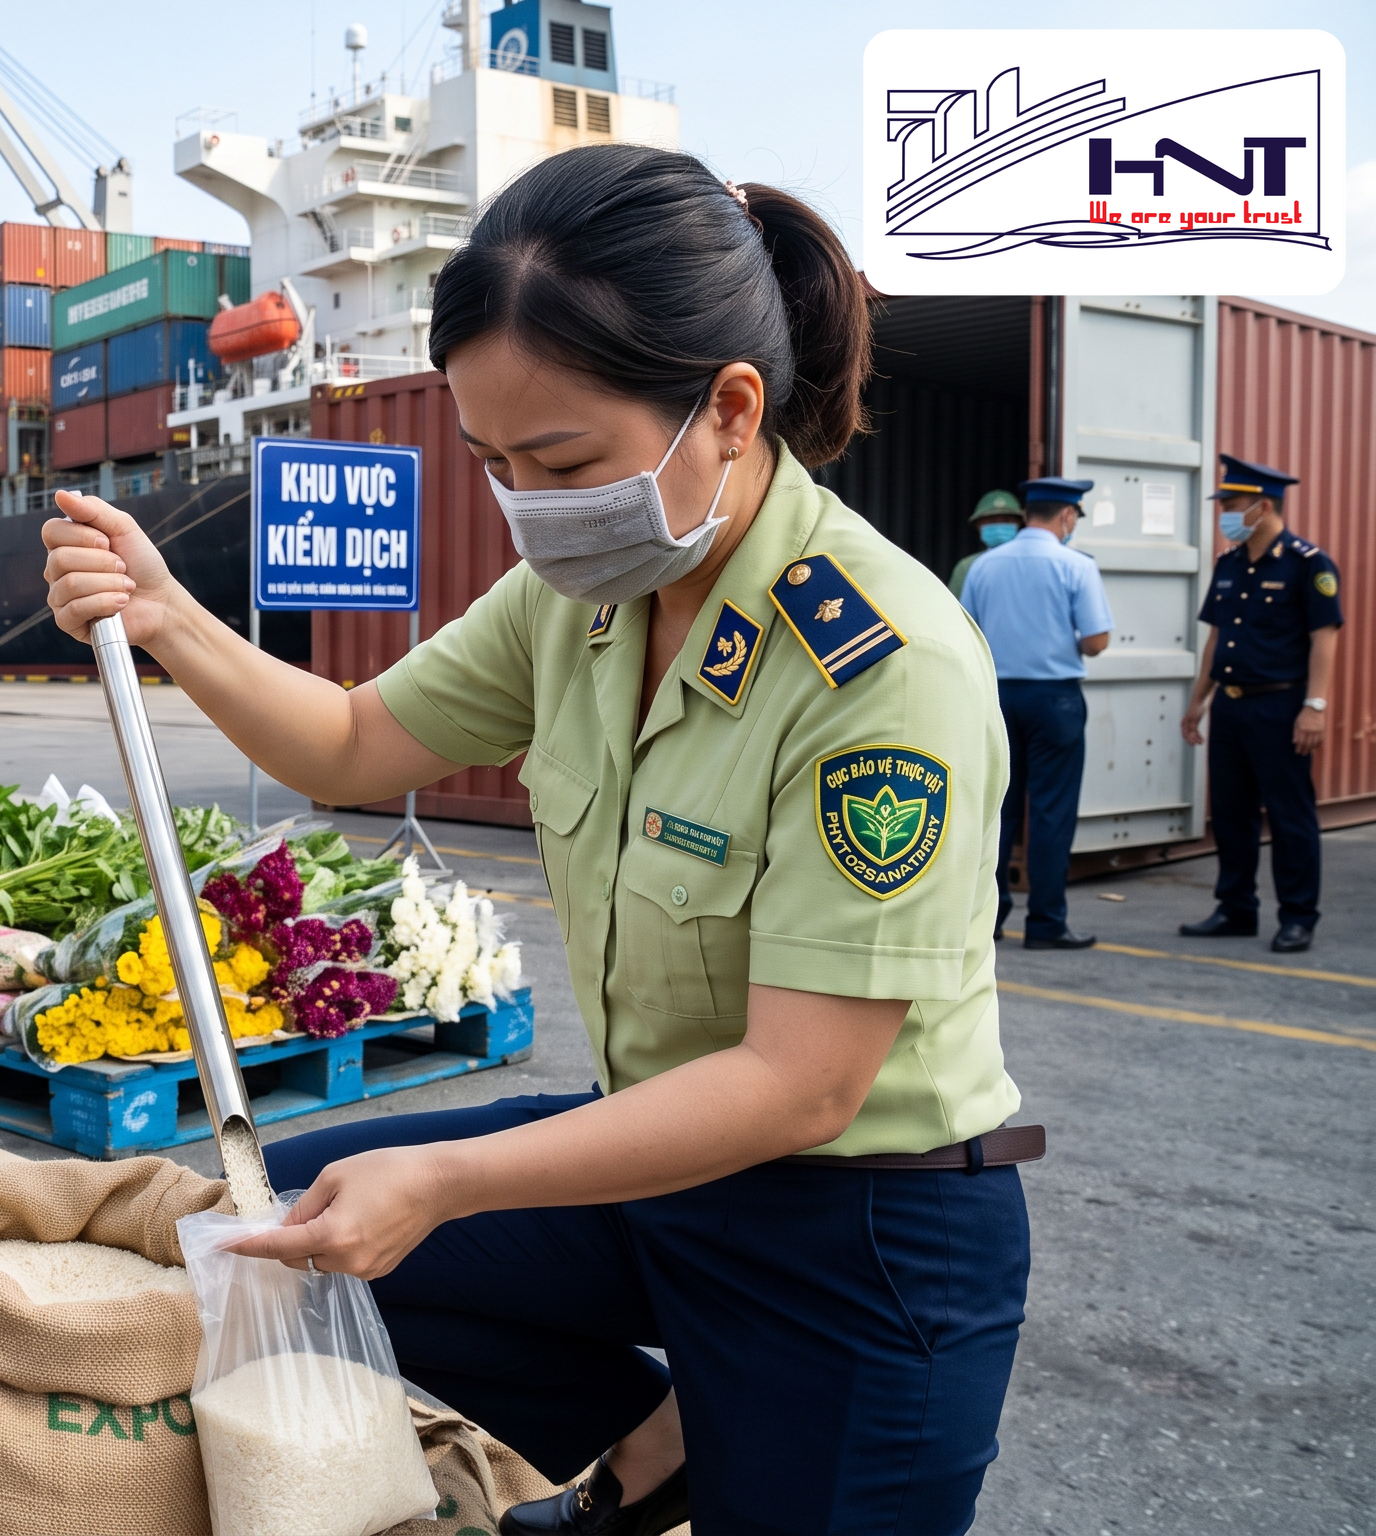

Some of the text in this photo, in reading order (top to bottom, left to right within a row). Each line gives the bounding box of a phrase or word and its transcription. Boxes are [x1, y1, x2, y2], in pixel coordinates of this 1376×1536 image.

[281, 461, 397, 516] KHU VỰC
[267, 509, 408, 577] KIỂM DỊCH
[826, 756, 944, 795] CỤC BẢO VỆ THỰC VẬT
